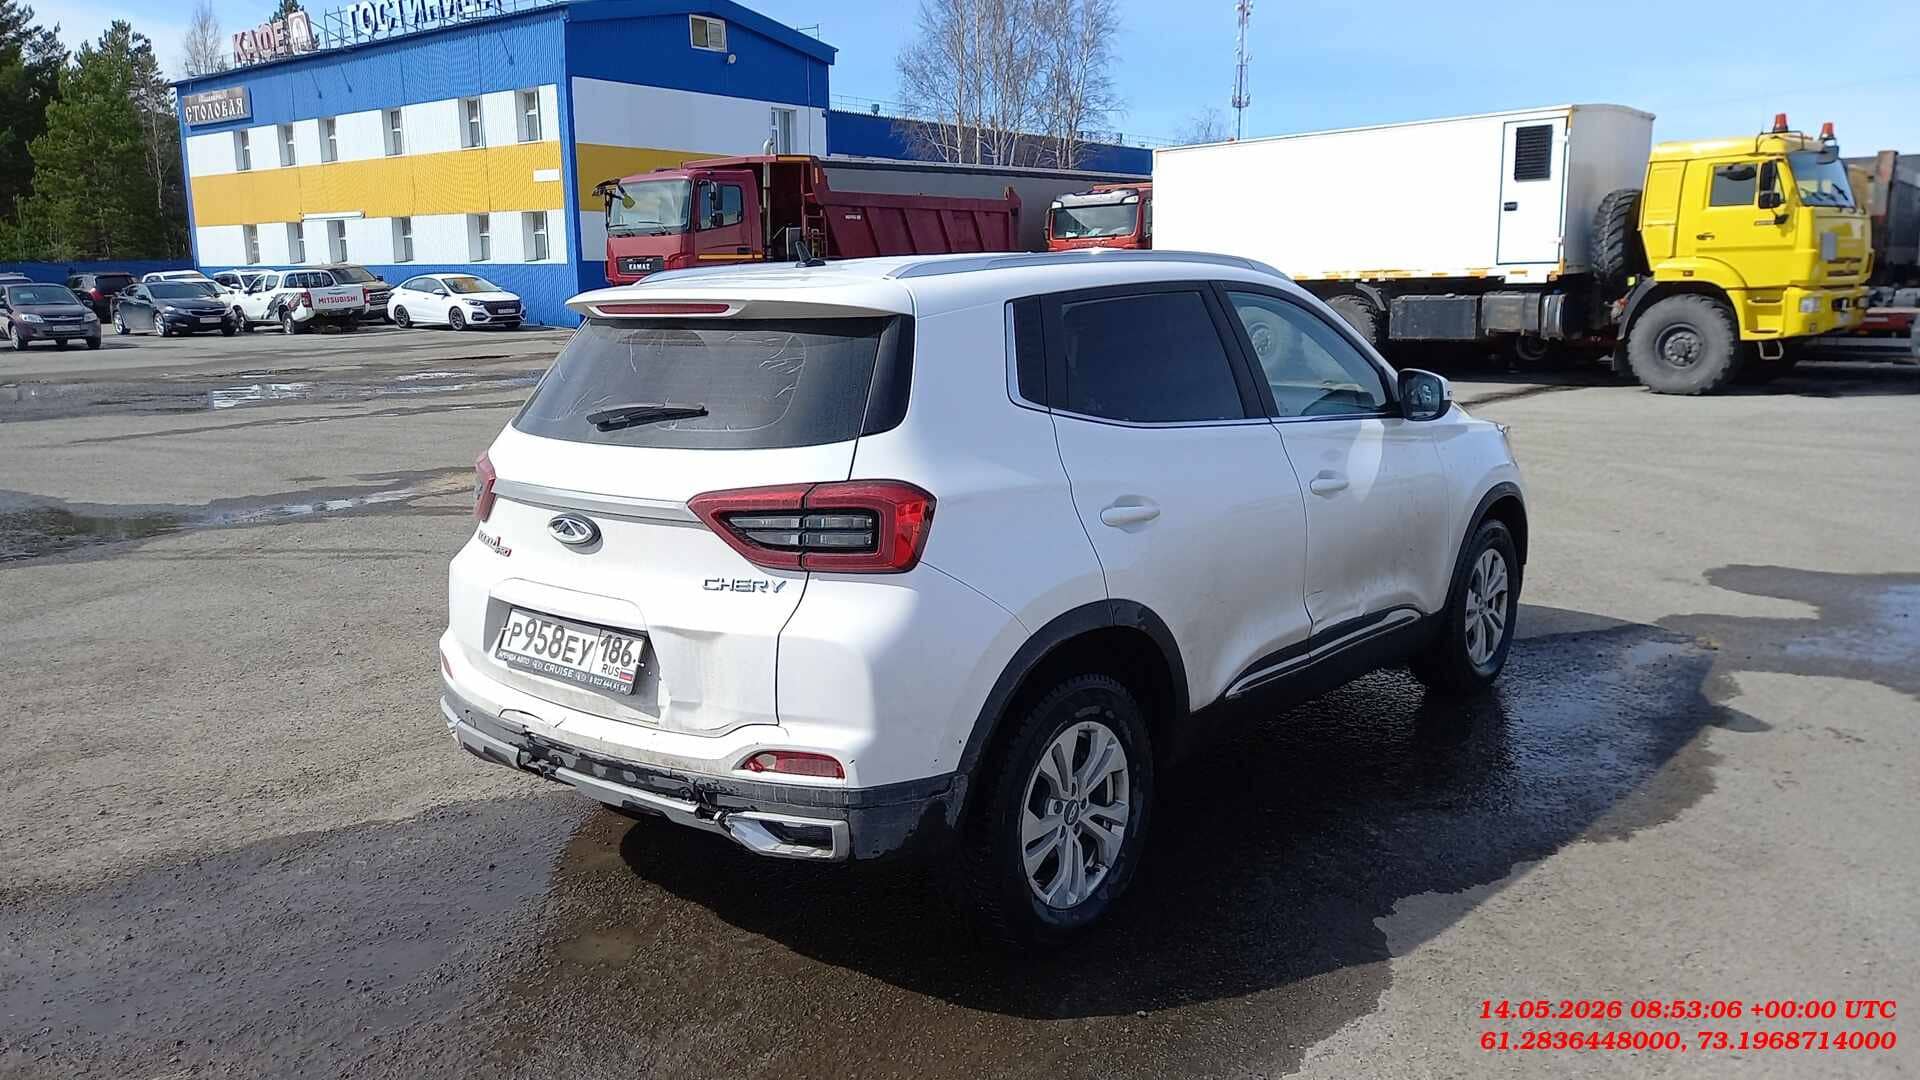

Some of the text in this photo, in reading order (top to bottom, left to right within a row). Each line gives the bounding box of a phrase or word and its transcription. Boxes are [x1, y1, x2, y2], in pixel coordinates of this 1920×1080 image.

[232, 19, 285, 63] КАФЕ
[185, 98, 244, 122] СТОЛОВАЯ
[319, 296, 357, 304] MITSUBISHI
[703, 577, 787, 593] CHERY
[600, 634, 632, 667] 186
[544, 663, 574, 677] CRUISE
[602, 663, 620, 677] RUS
